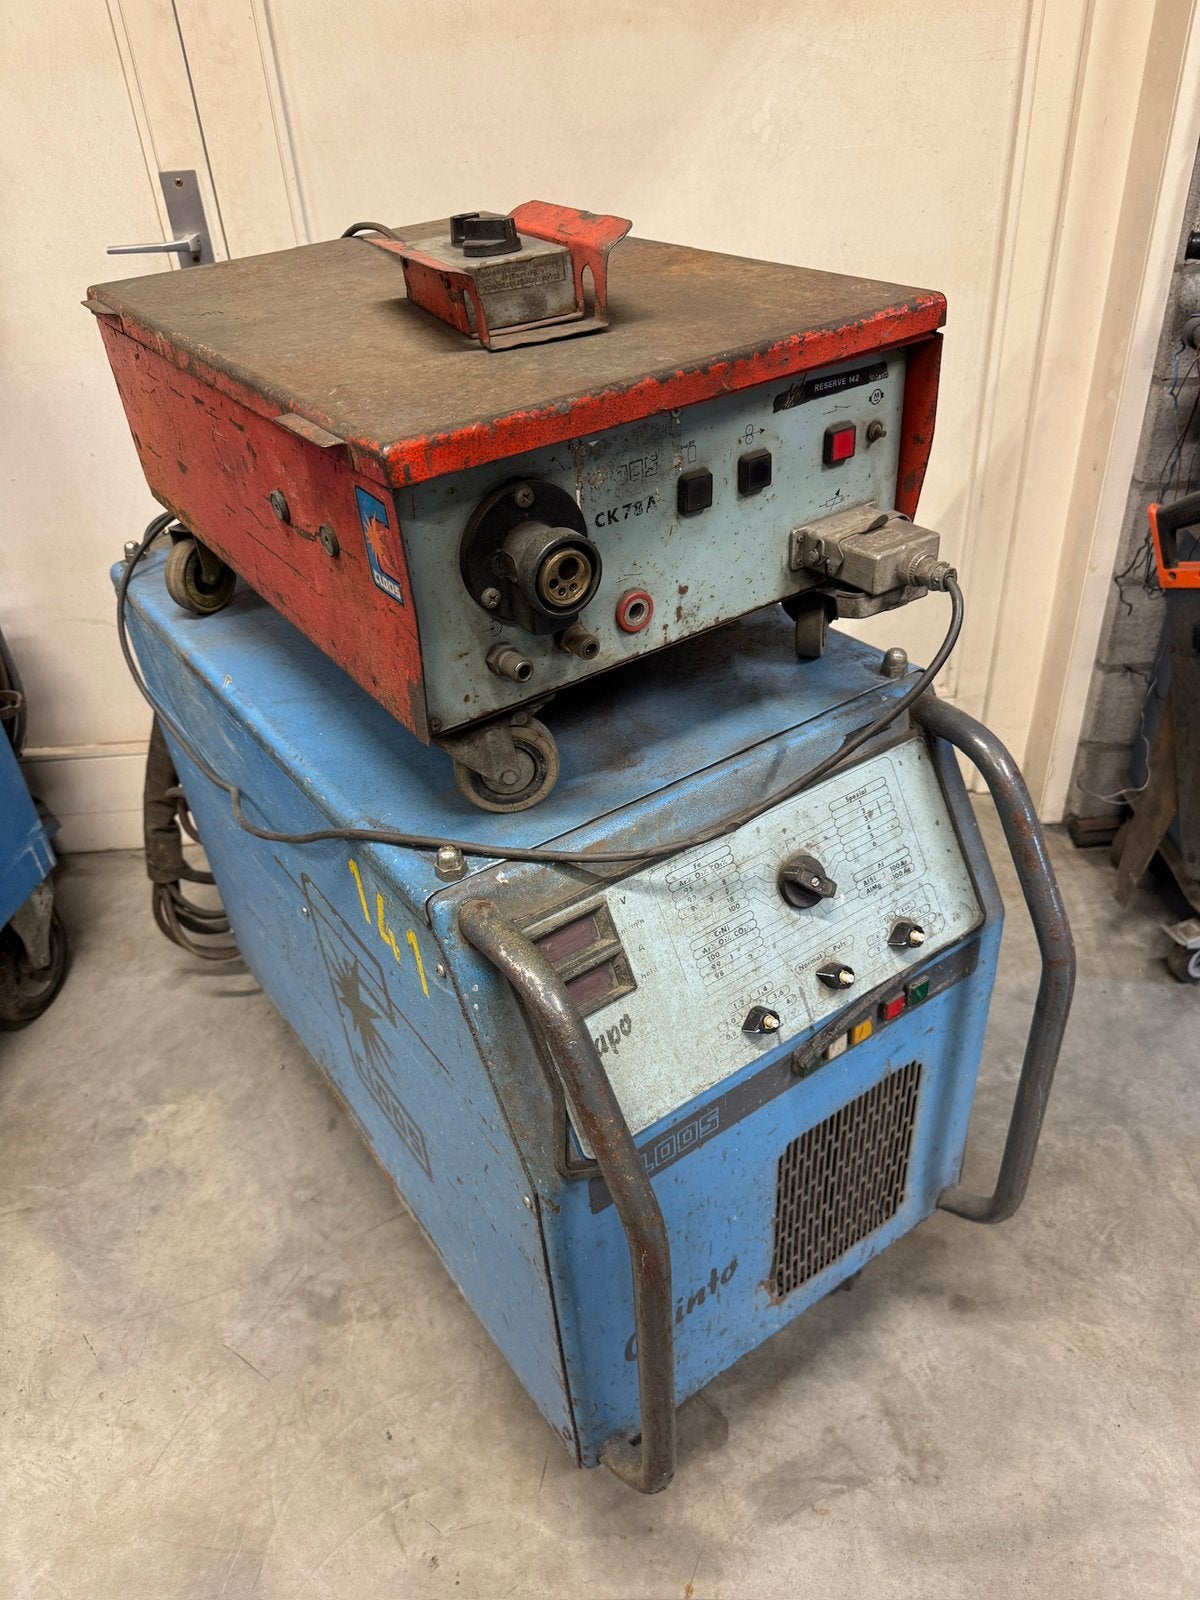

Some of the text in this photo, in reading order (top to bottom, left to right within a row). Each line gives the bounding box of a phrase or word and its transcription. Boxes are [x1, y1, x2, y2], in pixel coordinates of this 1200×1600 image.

[814, 374, 860, 392] RESERVE 142
[845, 788, 868, 804] Spezial
[728, 903, 741, 914] 100
[707, 951, 721, 962] 100
[638, 1106, 720, 1176] LOOS
